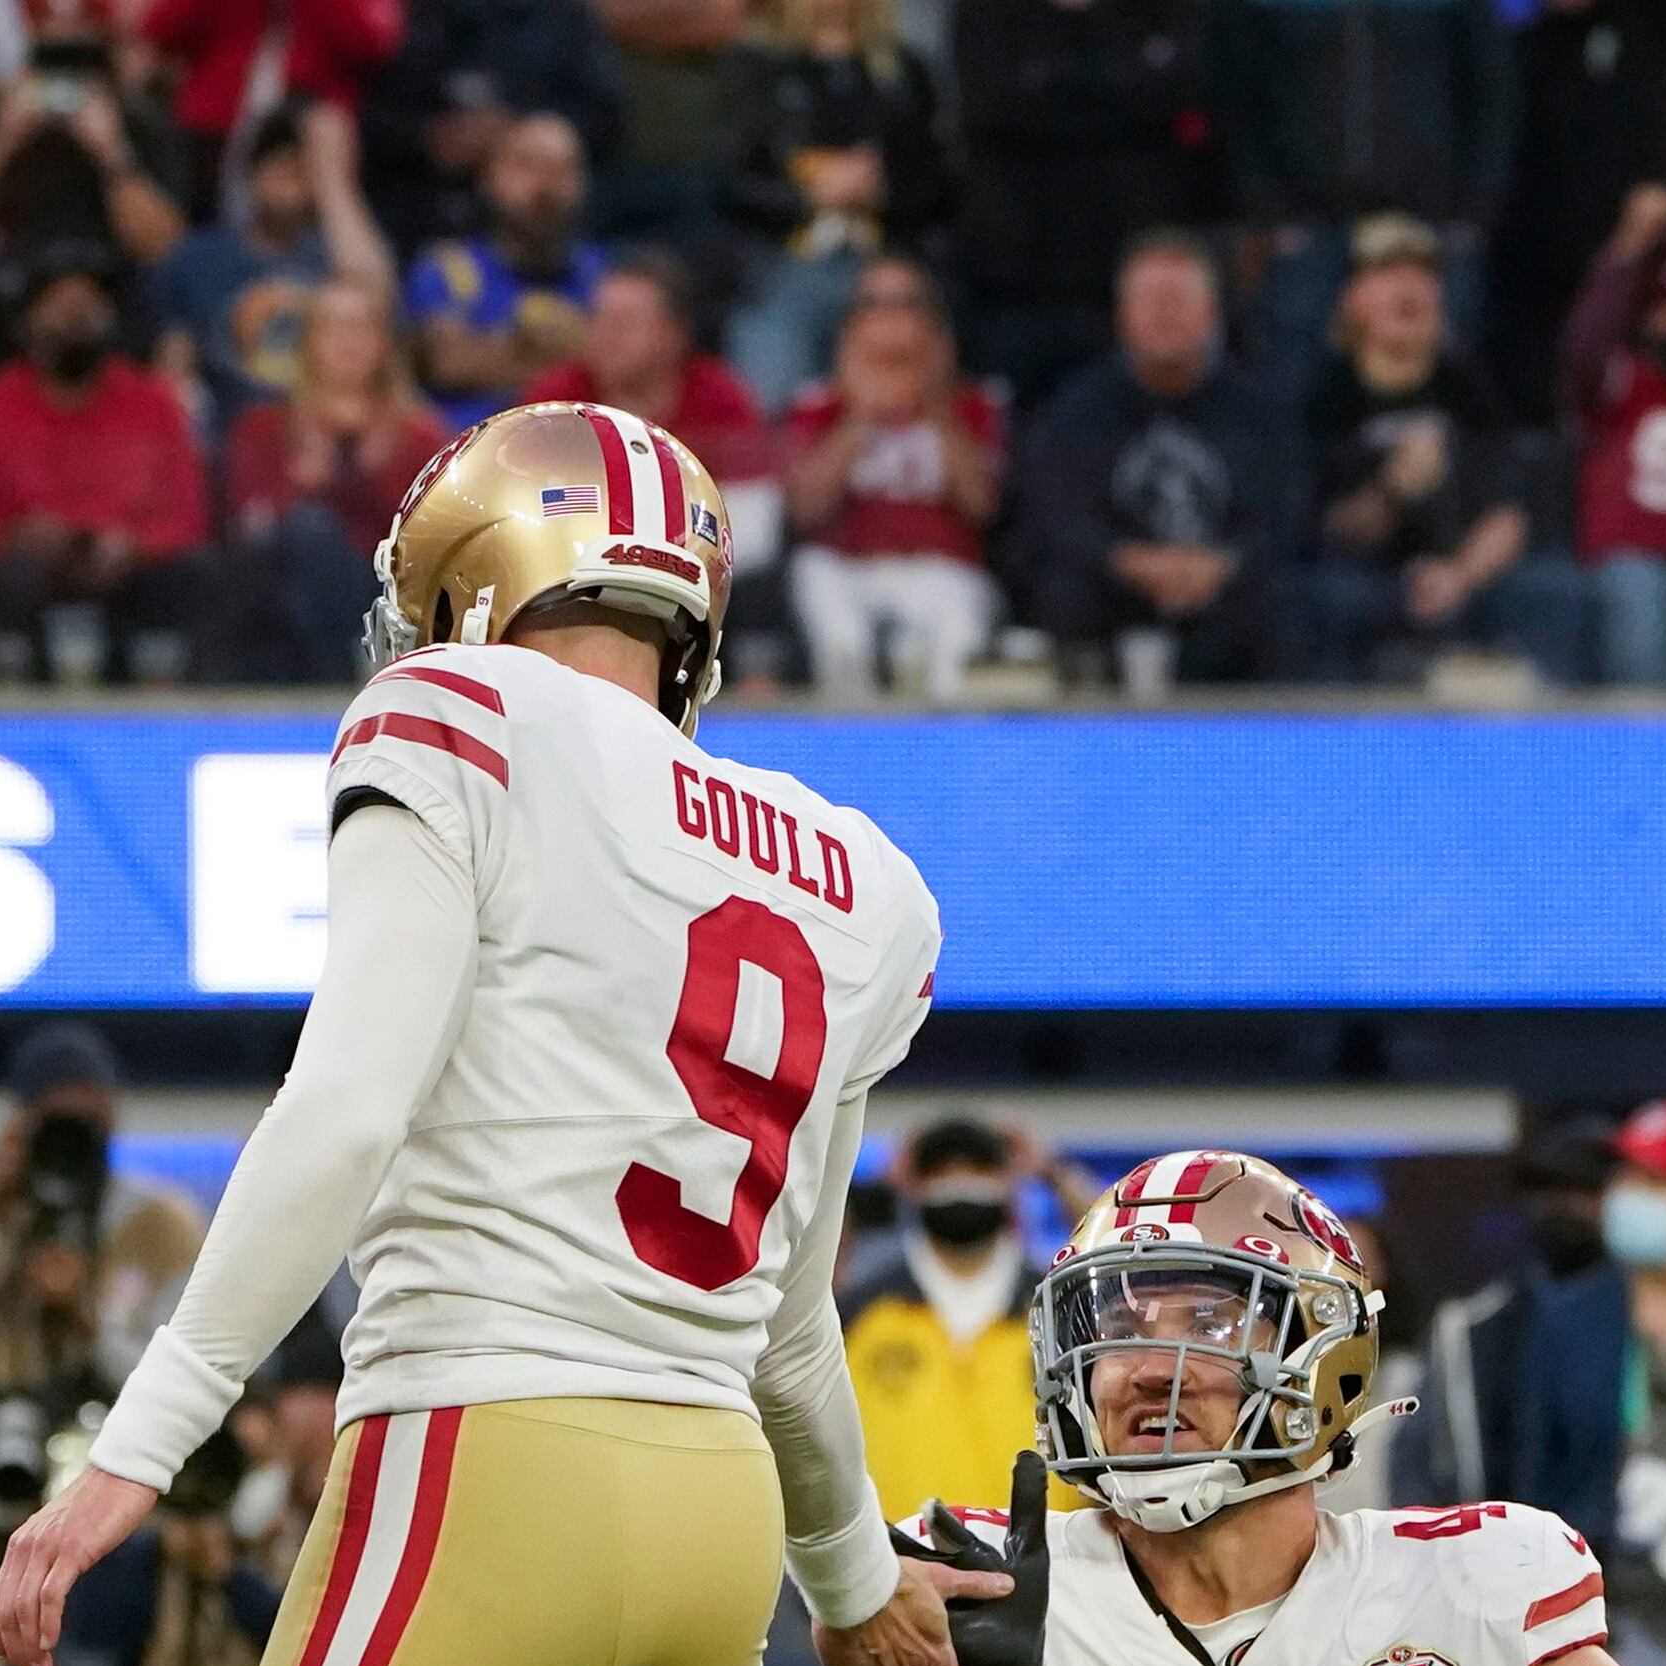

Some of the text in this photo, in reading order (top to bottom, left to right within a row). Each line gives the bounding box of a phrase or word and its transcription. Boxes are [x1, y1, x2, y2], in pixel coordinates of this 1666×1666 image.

[601, 543, 702, 585] 49ERS
[672, 759, 855, 914] GOULD
[615, 895, 828, 1292] 9
[1389, 1402, 1403, 1415] 44
